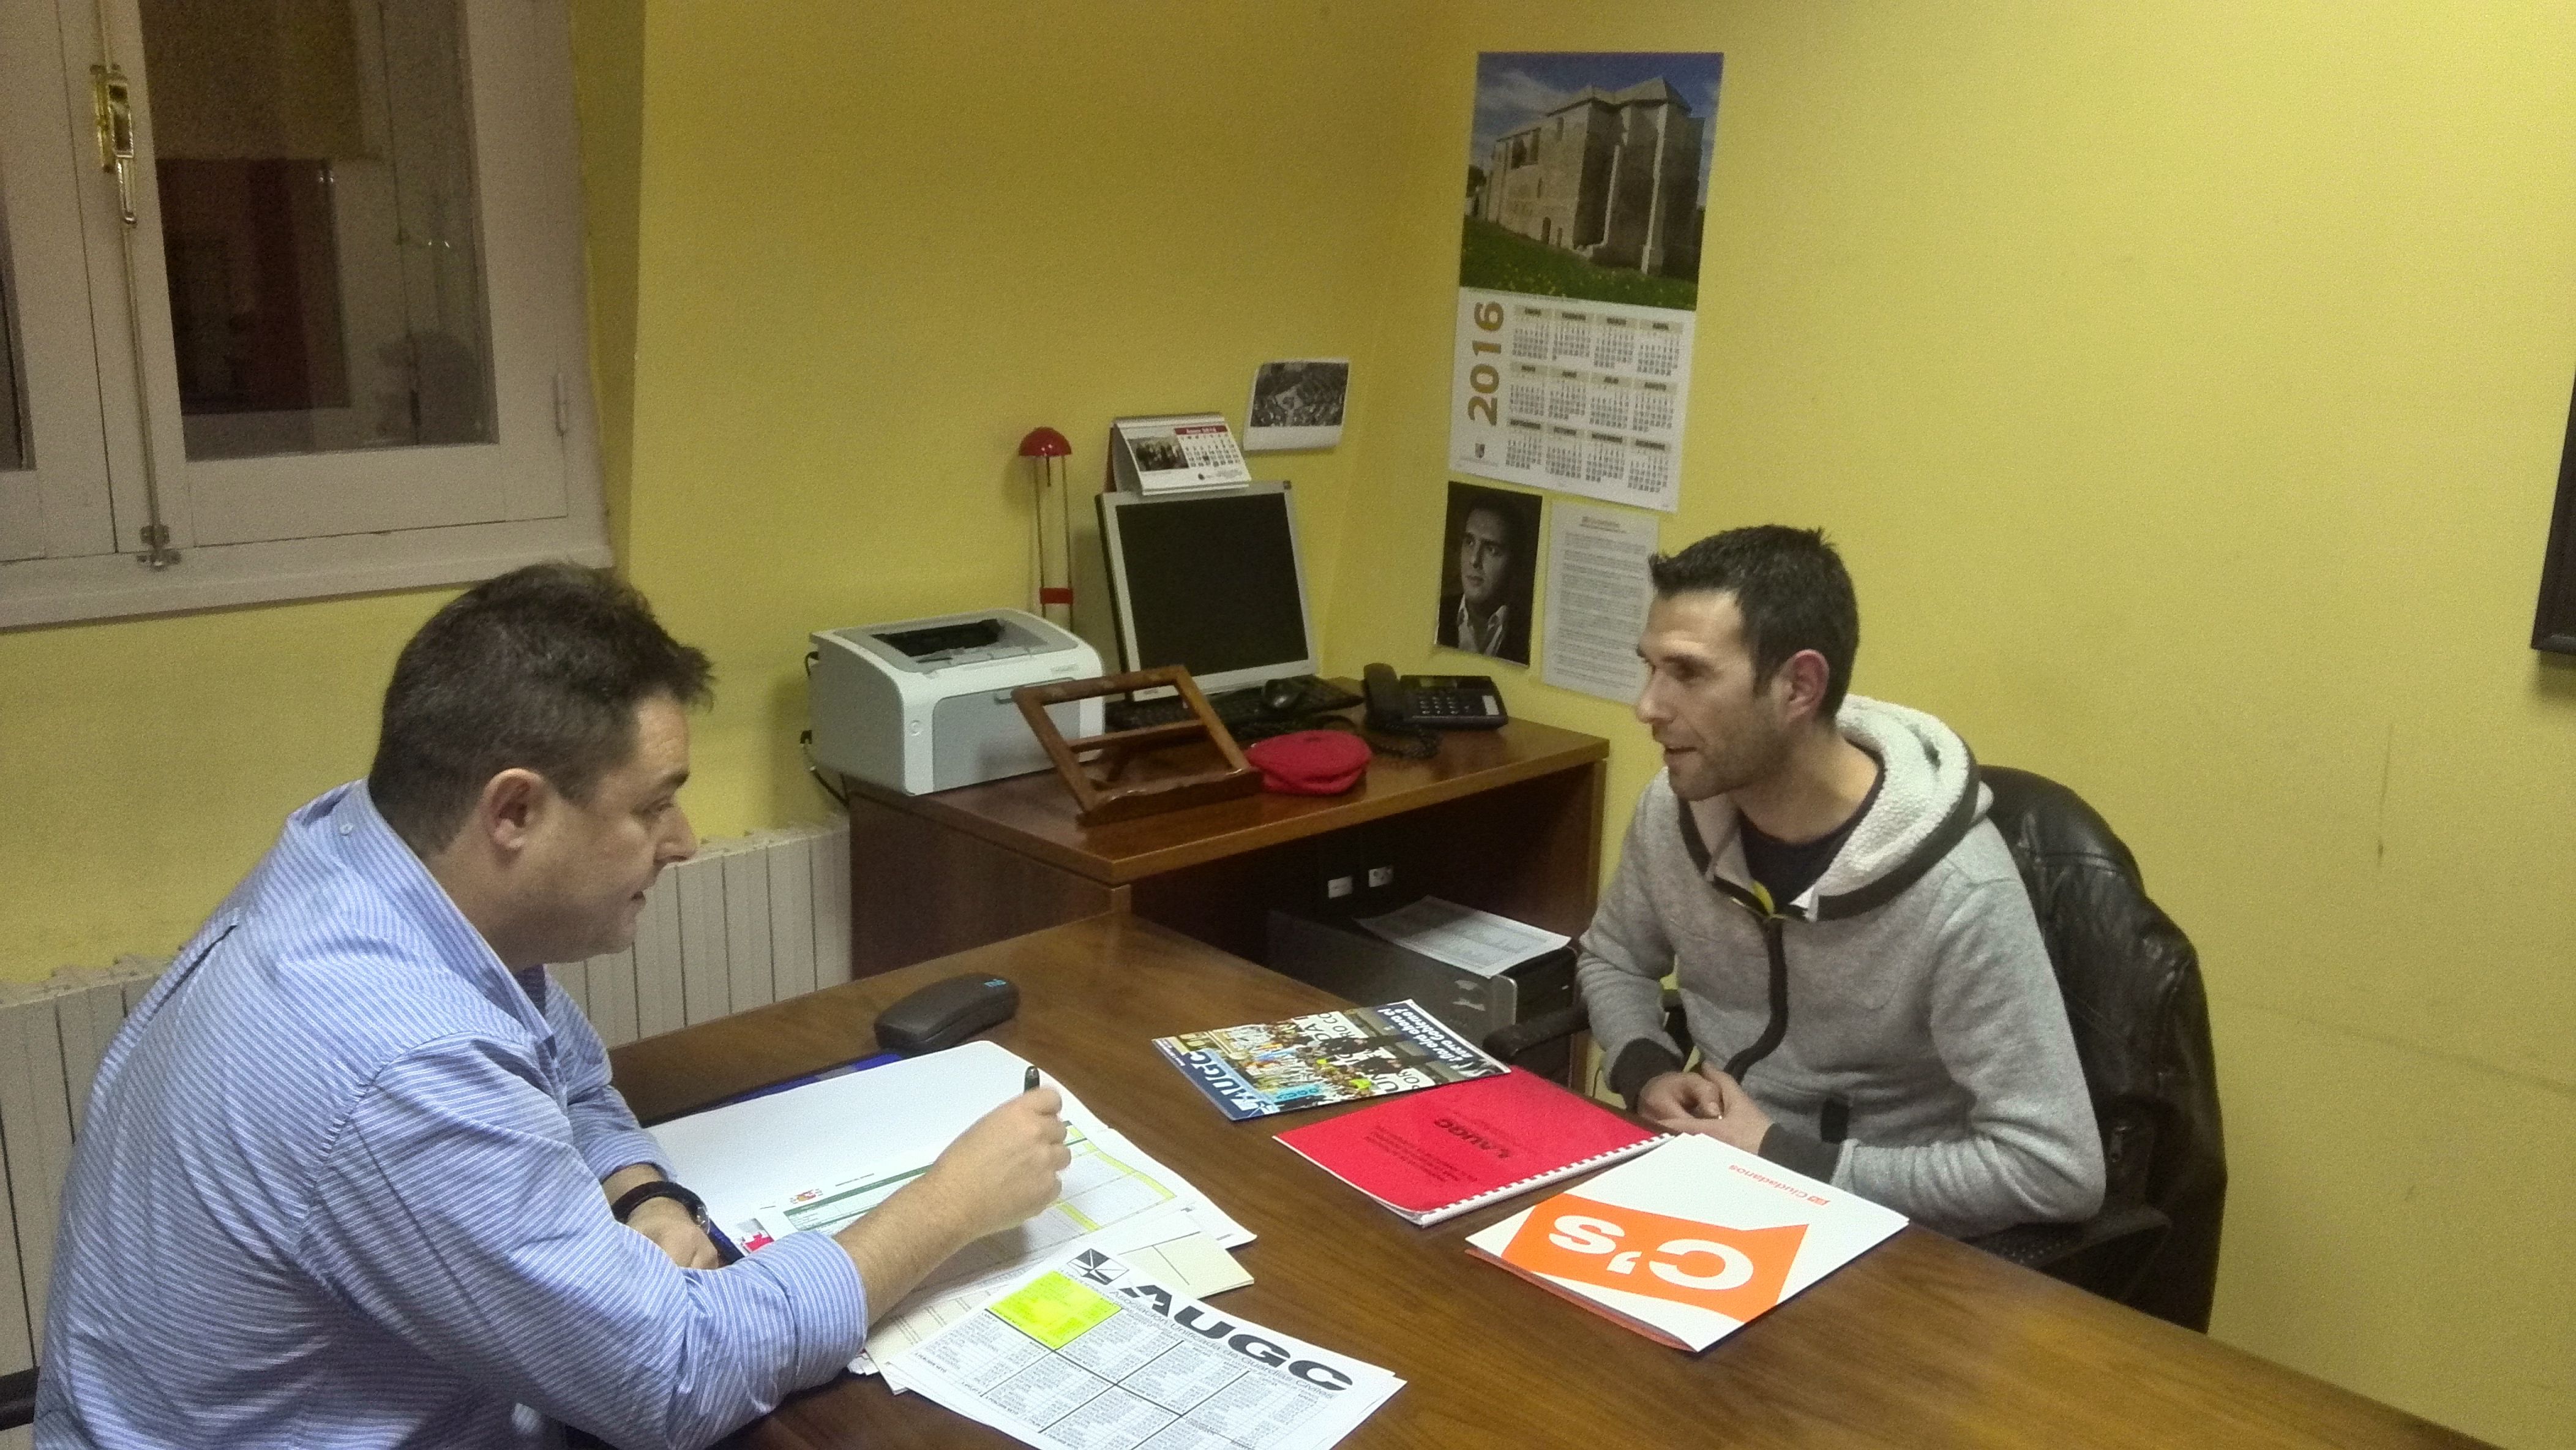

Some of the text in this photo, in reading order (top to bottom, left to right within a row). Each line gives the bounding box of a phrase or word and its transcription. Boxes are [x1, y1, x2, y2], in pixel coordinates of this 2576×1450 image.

[1467, 301, 1504, 426] 2016
[1391, 1016, 1420, 1034] ahora
[1395, 1009, 1445, 1040] Gobierno?
[1188, 1050, 1256, 1100] AUGC
[1729, 1164, 1808, 1198] Ciudadanos
[1109, 1290, 1169, 1325] Asociación
[1170, 1323, 1221, 1351] Unificada
[1241, 1356, 1293, 1381] Guardias
[1295, 1380, 1335, 1399] Civiles
[1118, 1285, 1353, 1391] AUGC
